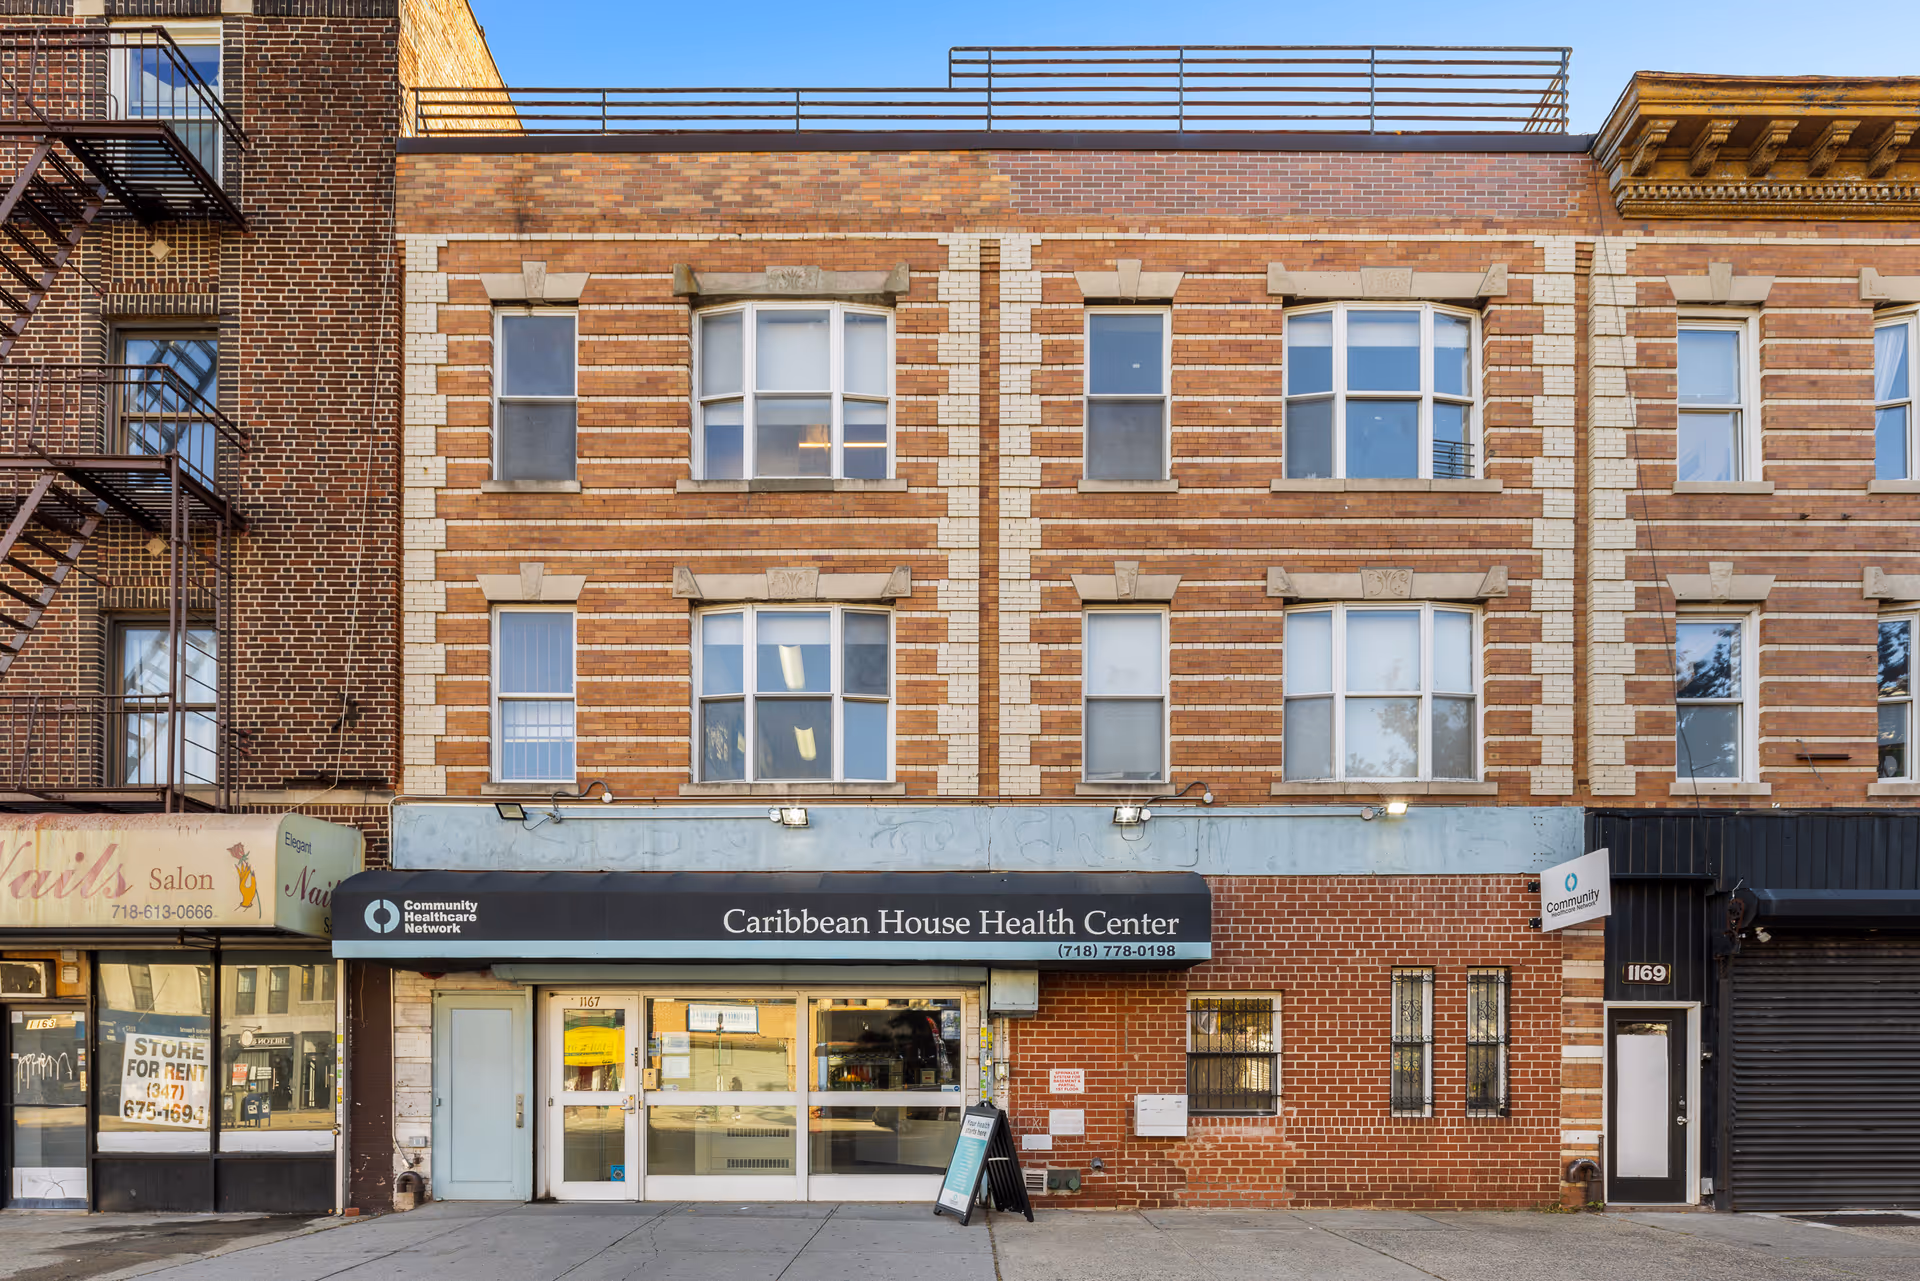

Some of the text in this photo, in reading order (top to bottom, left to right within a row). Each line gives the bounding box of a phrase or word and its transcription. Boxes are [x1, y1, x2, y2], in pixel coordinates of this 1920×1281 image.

[284, 831, 312, 855] Elegant
[149, 866, 215, 891] Salon
[403, 899, 478, 913] Community
[1546, 889, 1600, 914] Community
[1551, 900, 1597, 918] Healthcare Network
[112, 903, 213, 920] 718-613-0666
[404, 911, 477, 922] Healthcare
[404, 923, 462, 934] Network
[723, 908, 1180, 935] Caribbean House Health Center
[1058, 943, 1176, 959] (718) 778-0198
[1628, 964, 1666, 982] 1169
[579, 996, 600, 1008] 1167
[29, 1019, 55, 1028] 1163
[133, 1037, 206, 1061] STORE
[126, 1058, 160, 1079] FOR
[164, 1061, 208, 1083] RENT
[146, 1082, 185, 1101] (347)
[123, 1099, 205, 1125] 675-1694
